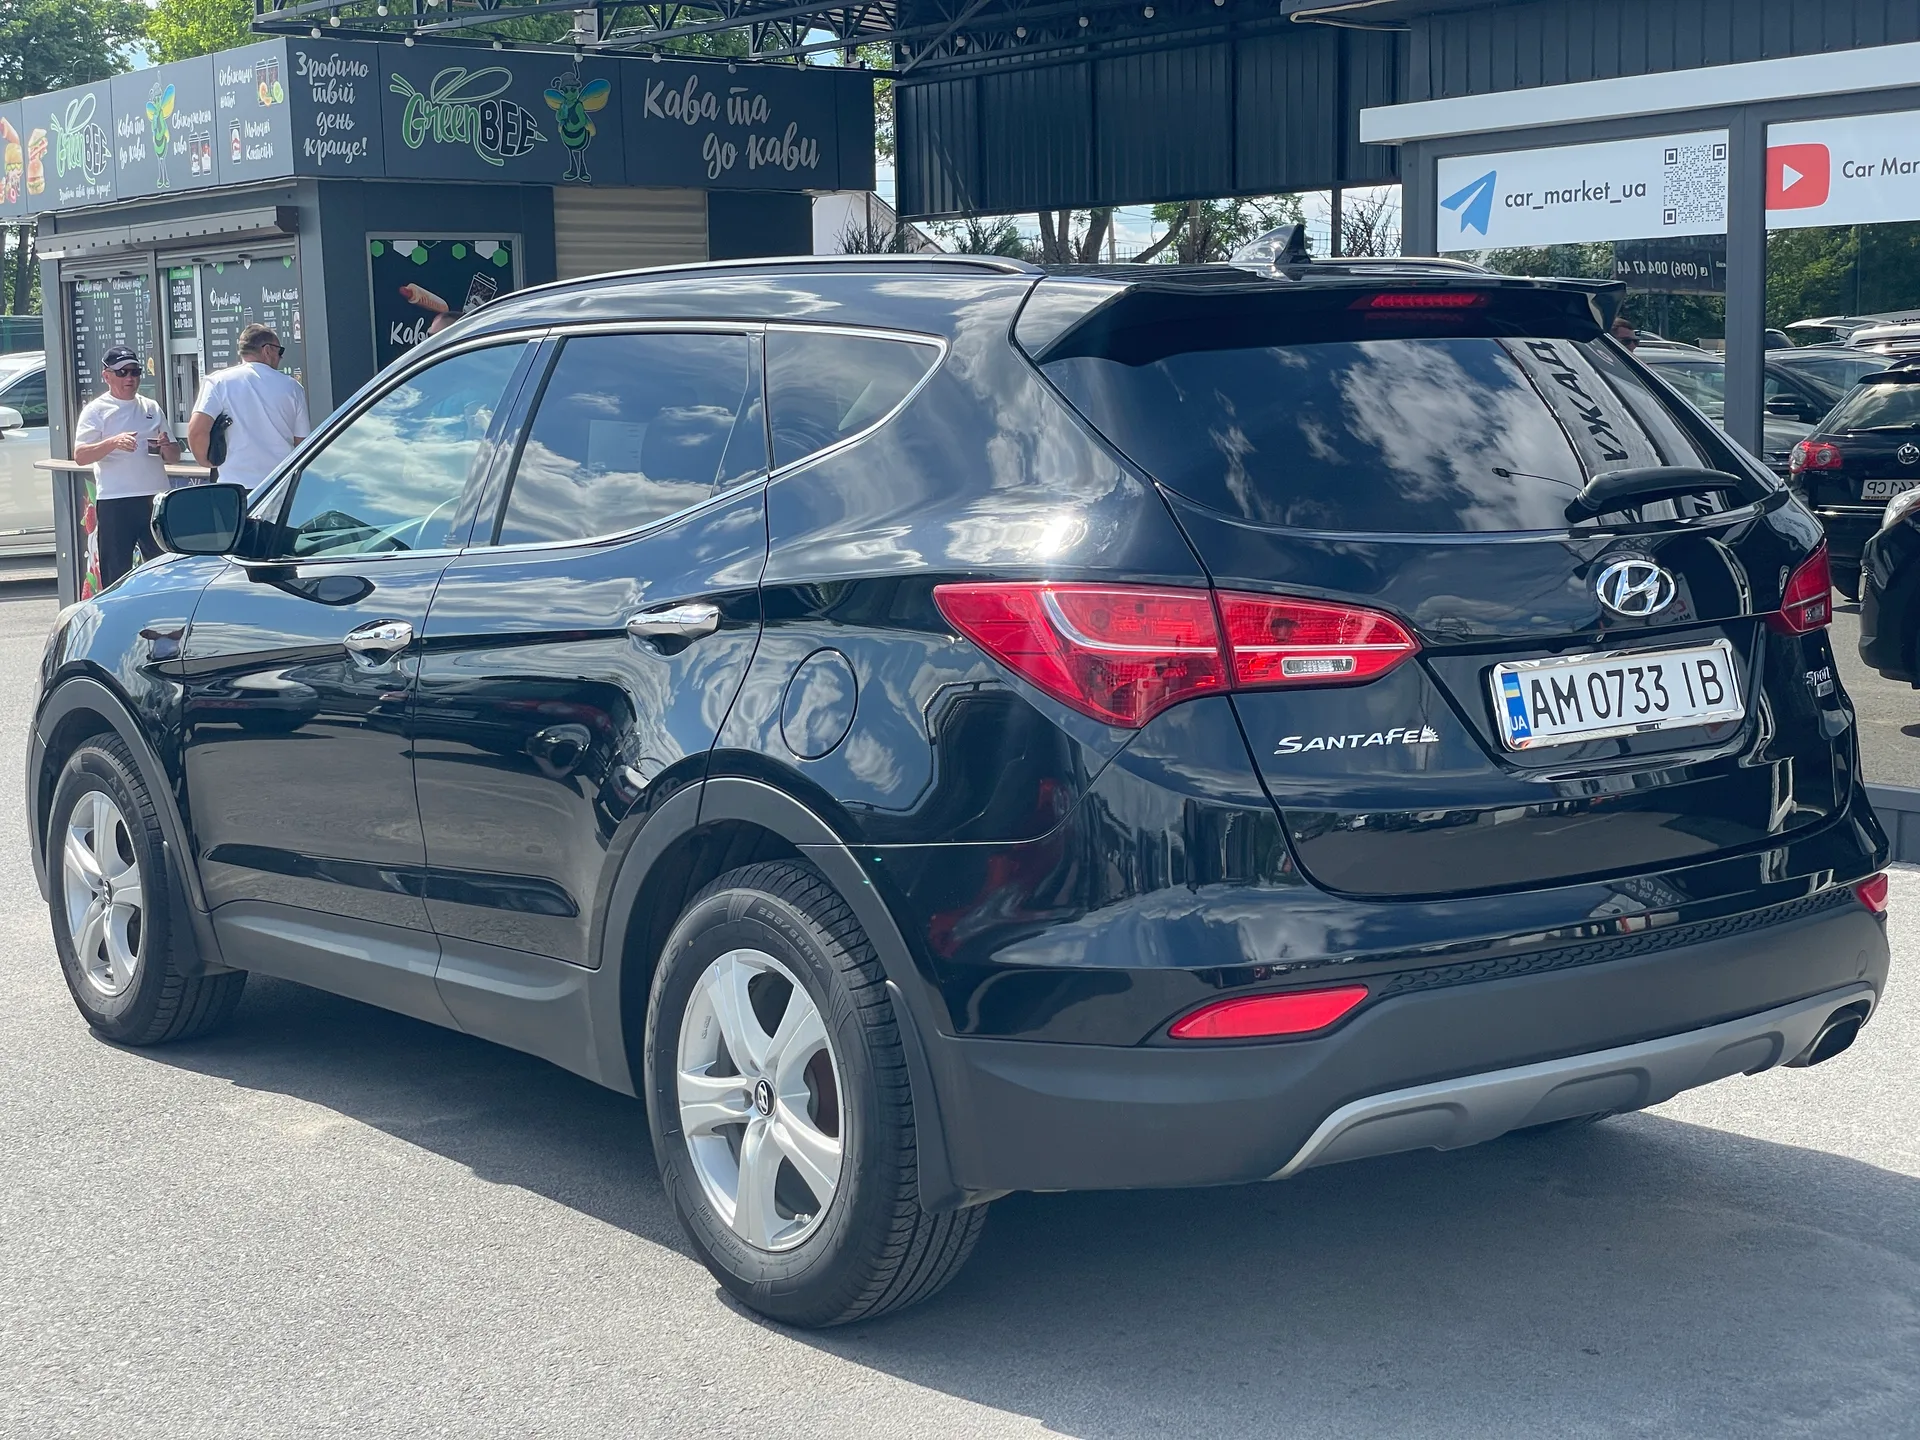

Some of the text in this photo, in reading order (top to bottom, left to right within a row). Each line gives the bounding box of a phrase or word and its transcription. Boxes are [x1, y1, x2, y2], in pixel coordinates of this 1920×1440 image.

[295, 52, 369, 84] Зробимо
[312, 79, 356, 104] твій
[643, 74, 771, 125] Кава та
[117, 114, 134, 138] Кава
[316, 111, 355, 136] день
[303, 137, 368, 166] краще!
[702, 122, 821, 180] до кави
[1842, 157, 1920, 179] Car Mar
[1504, 179, 1647, 210] car_market_ua
[1531, 659, 1724, 729] AM 0733 IB
[1511, 715, 1528, 732] UA
